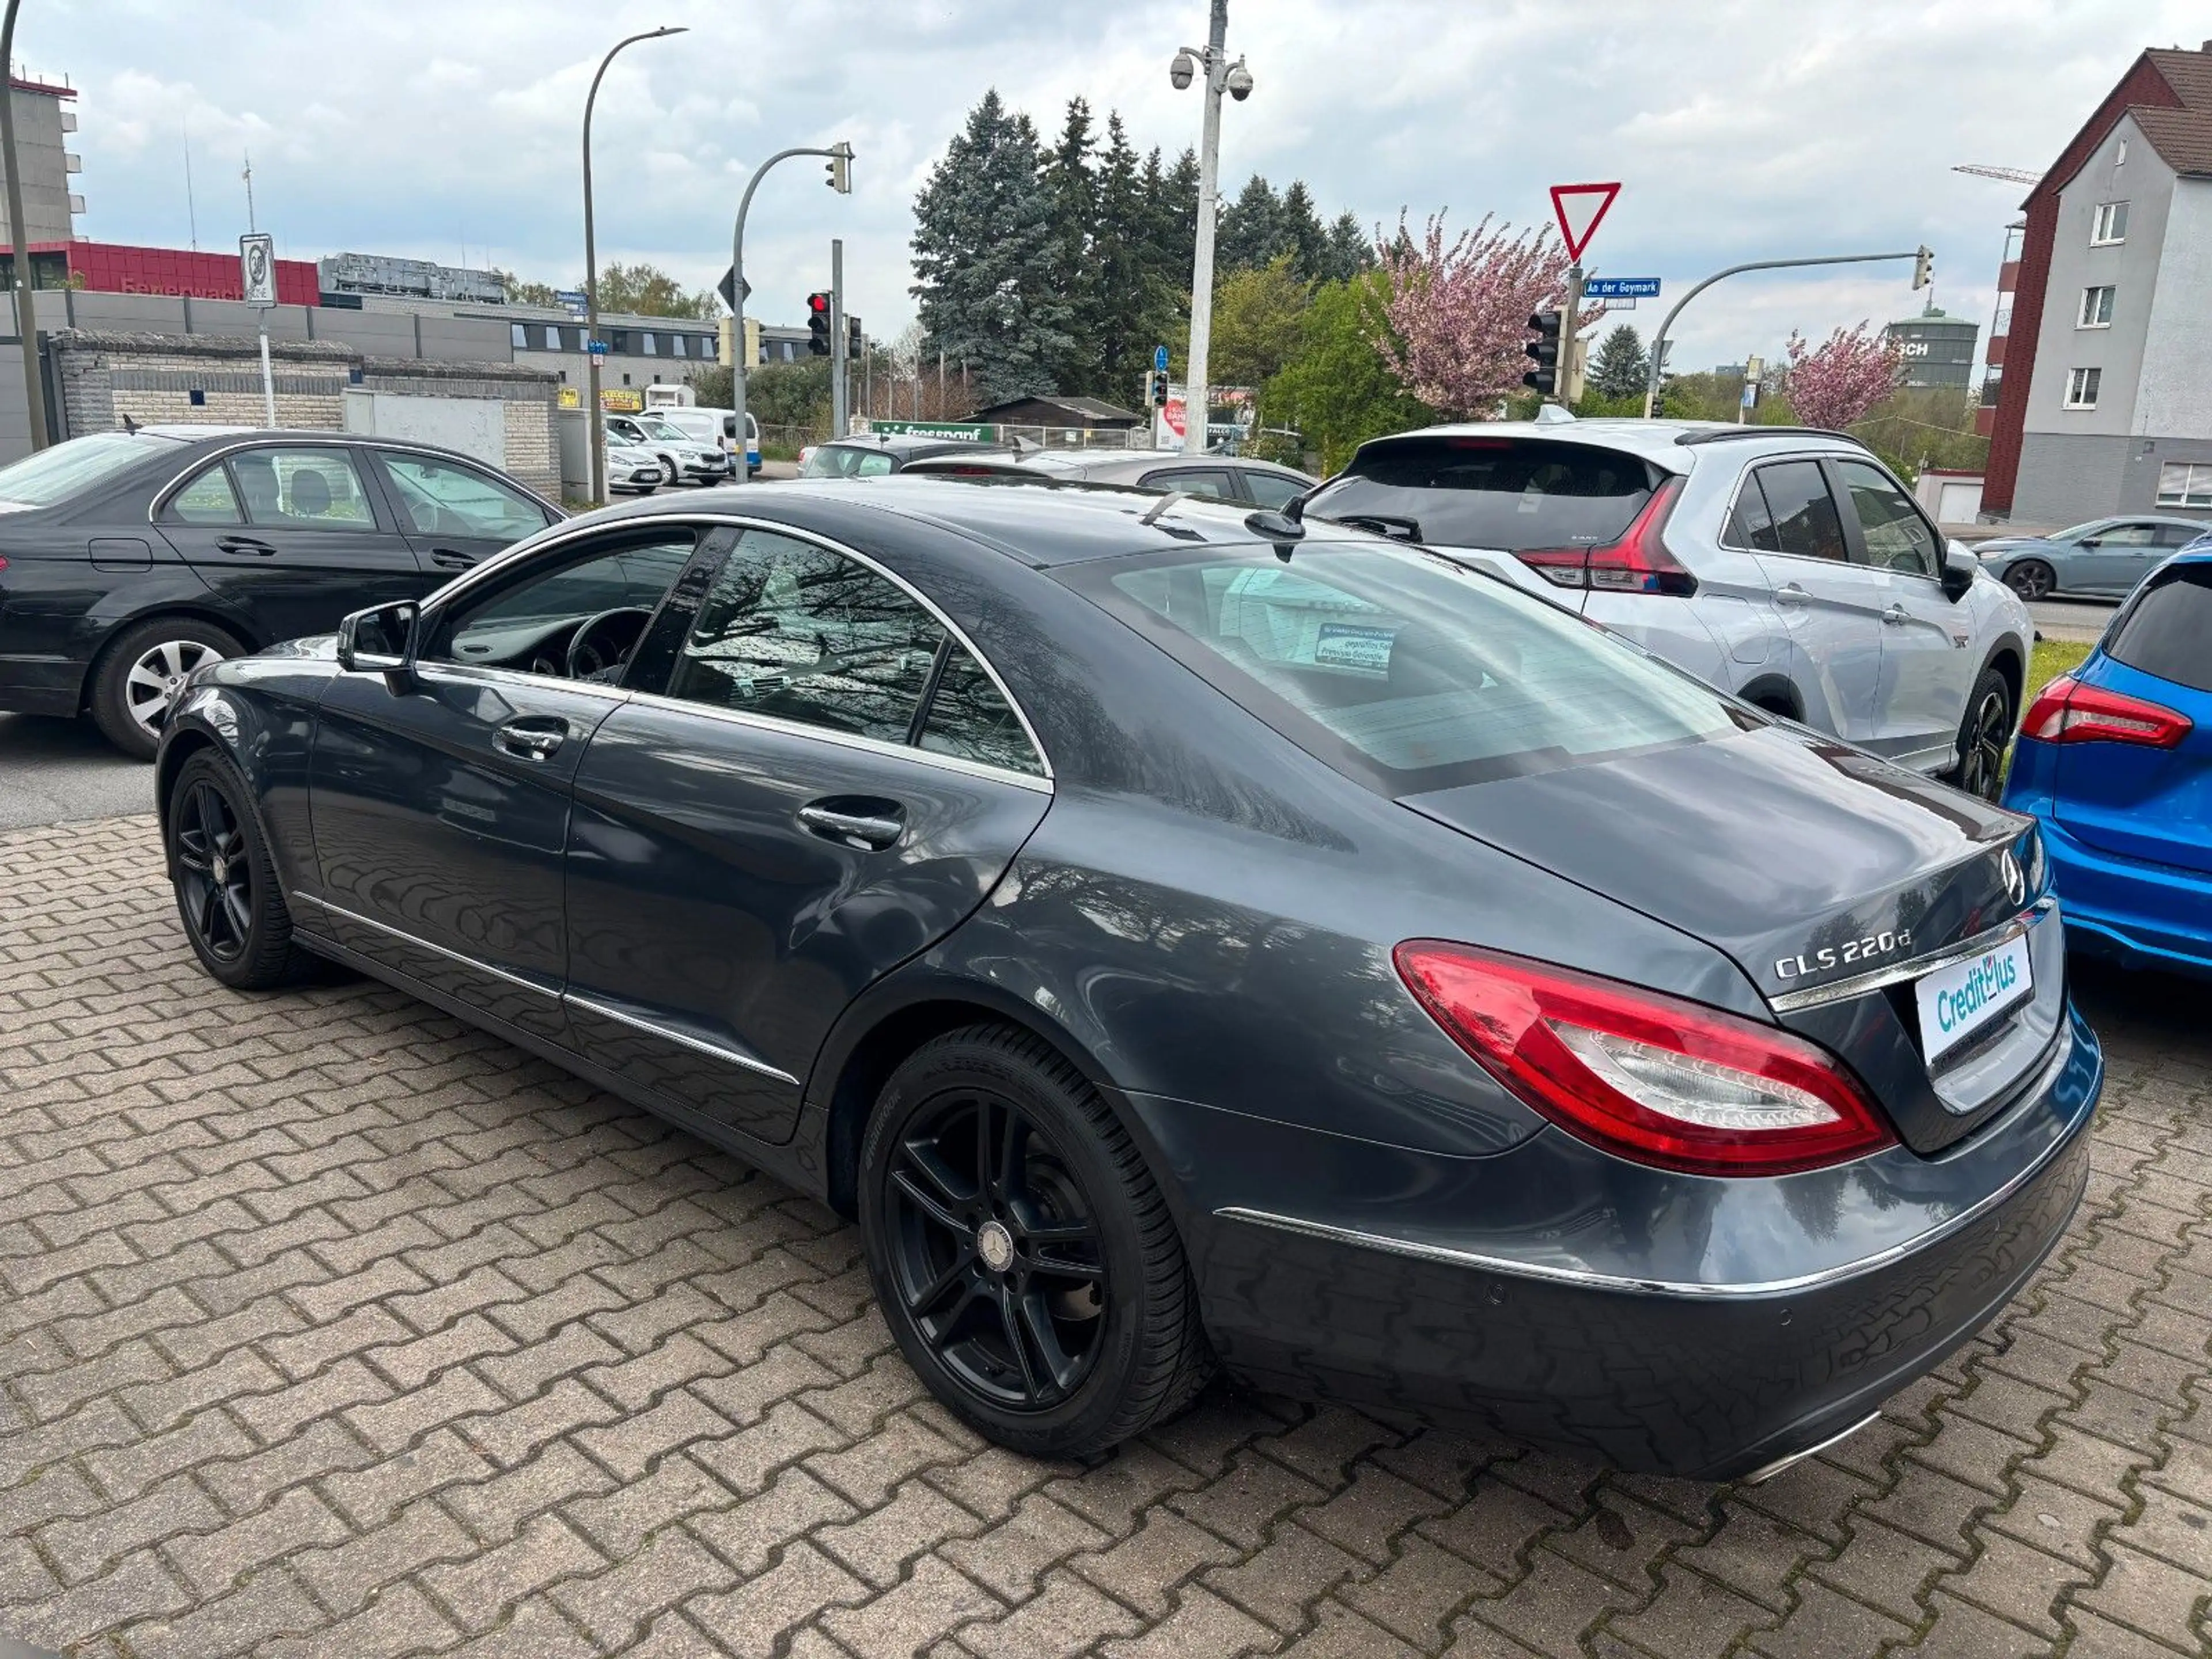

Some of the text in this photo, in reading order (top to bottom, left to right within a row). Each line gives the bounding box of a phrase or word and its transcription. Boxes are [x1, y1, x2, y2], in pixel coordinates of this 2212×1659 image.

[1602, 282, 1616, 293] der
[1898, 343, 1929, 357] SCH
[1775, 948, 1836, 980] CLS
[1938, 954, 2016, 1032] CreditPlus
